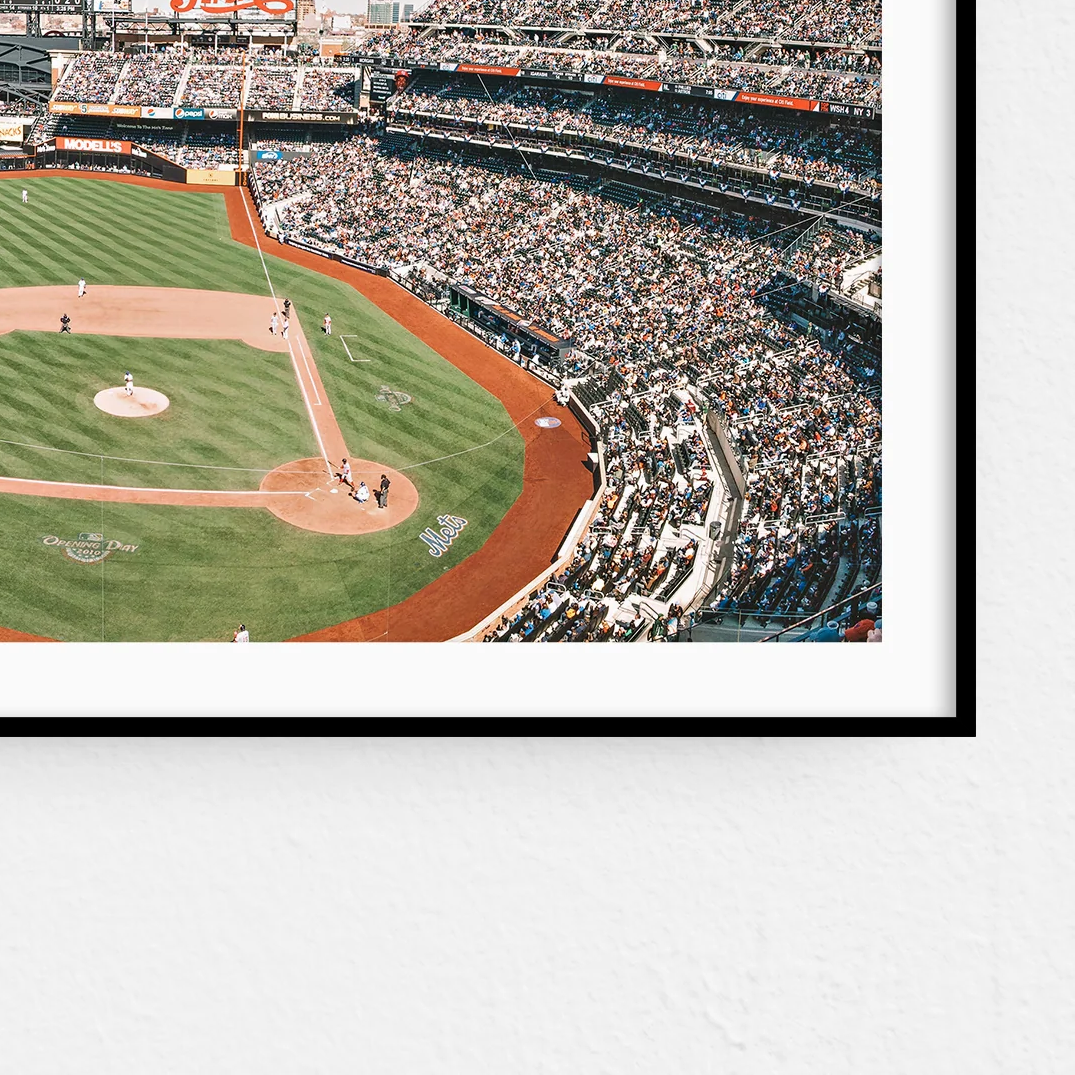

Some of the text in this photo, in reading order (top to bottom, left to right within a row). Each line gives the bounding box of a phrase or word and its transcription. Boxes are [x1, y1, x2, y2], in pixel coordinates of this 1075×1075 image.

[757, 96, 774, 104] experience
[184, 110, 203, 118] pepsi
[829, 104, 845, 113] WSH
[845, 106, 849, 114] 4
[853, 106, 863, 115] NY
[866, 109, 871, 117] 3
[64, 138, 122, 153] MODELL'S
[419, 514, 468, 557] Mets
